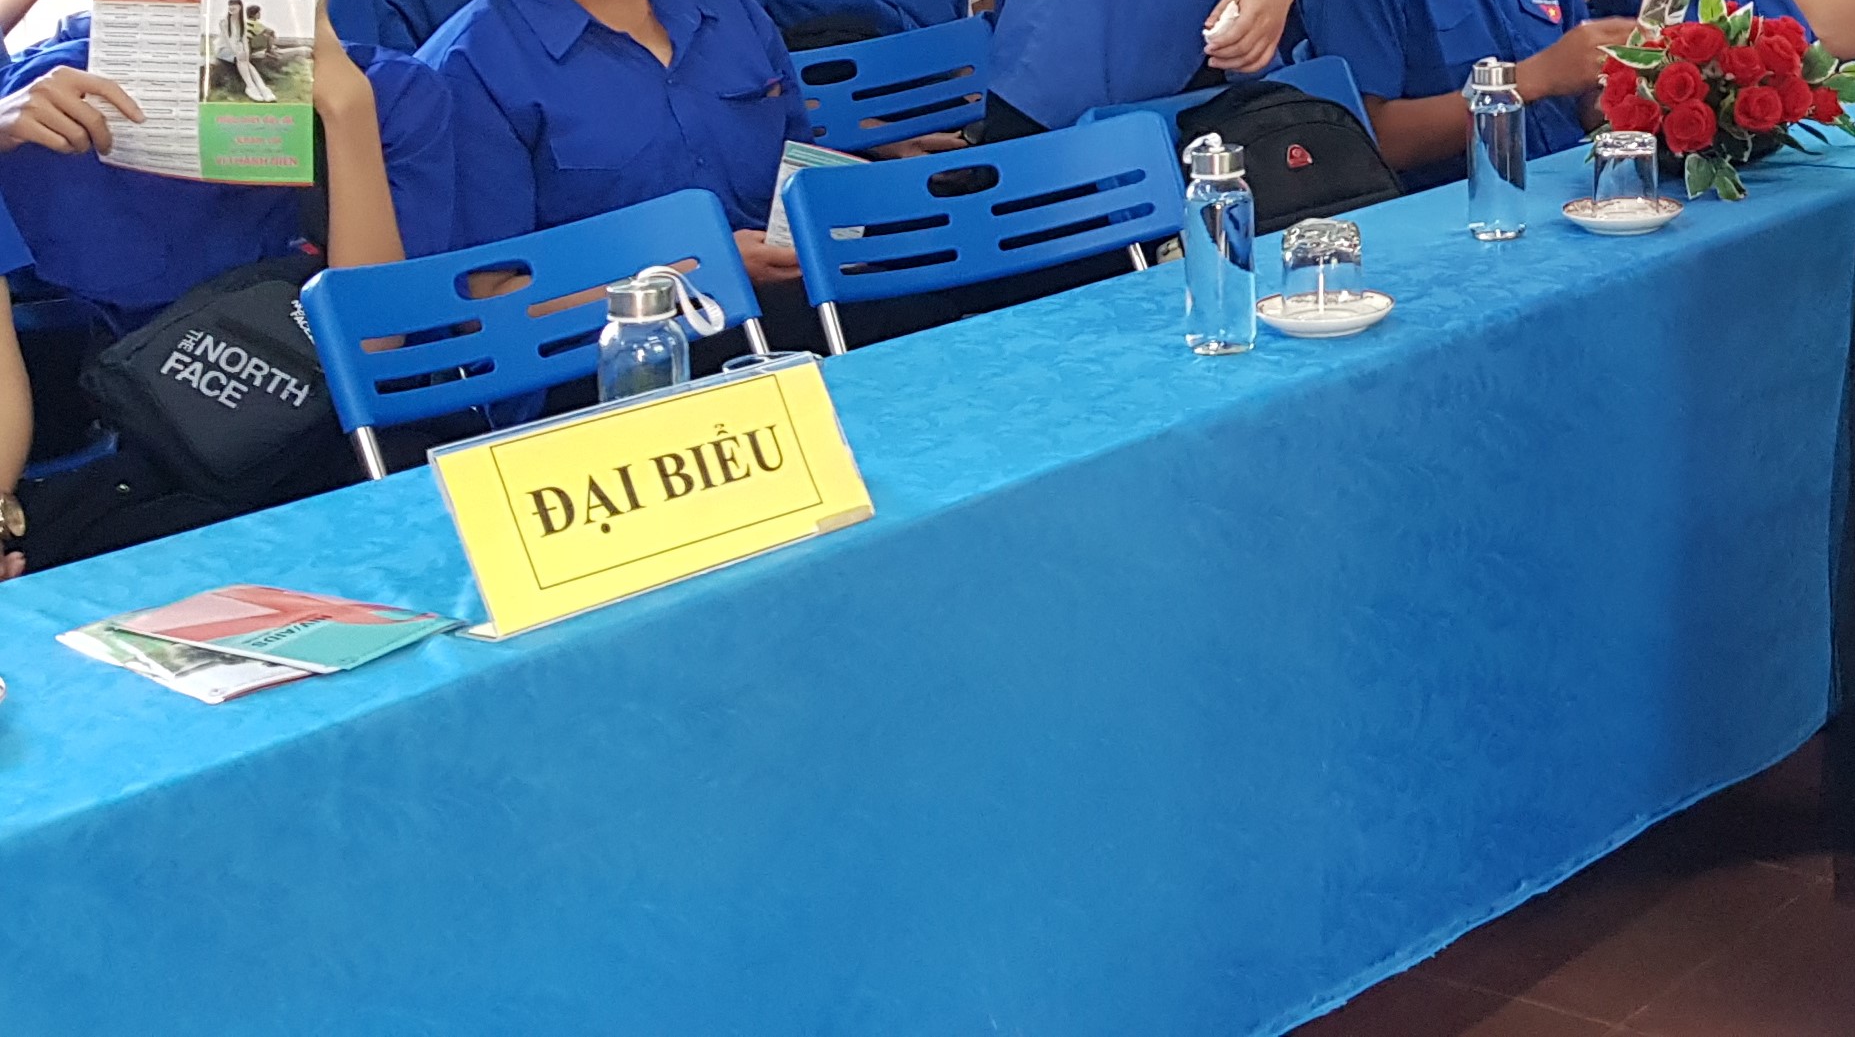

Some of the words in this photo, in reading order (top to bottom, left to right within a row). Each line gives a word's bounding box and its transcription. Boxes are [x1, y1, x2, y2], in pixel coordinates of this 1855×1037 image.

[160, 351, 249, 409] FACE
[177, 329, 204, 352] THE
[194, 334, 310, 407] NORTH
[526, 464, 646, 537] ĐẠI
[648, 423, 784, 502] BIỂU
